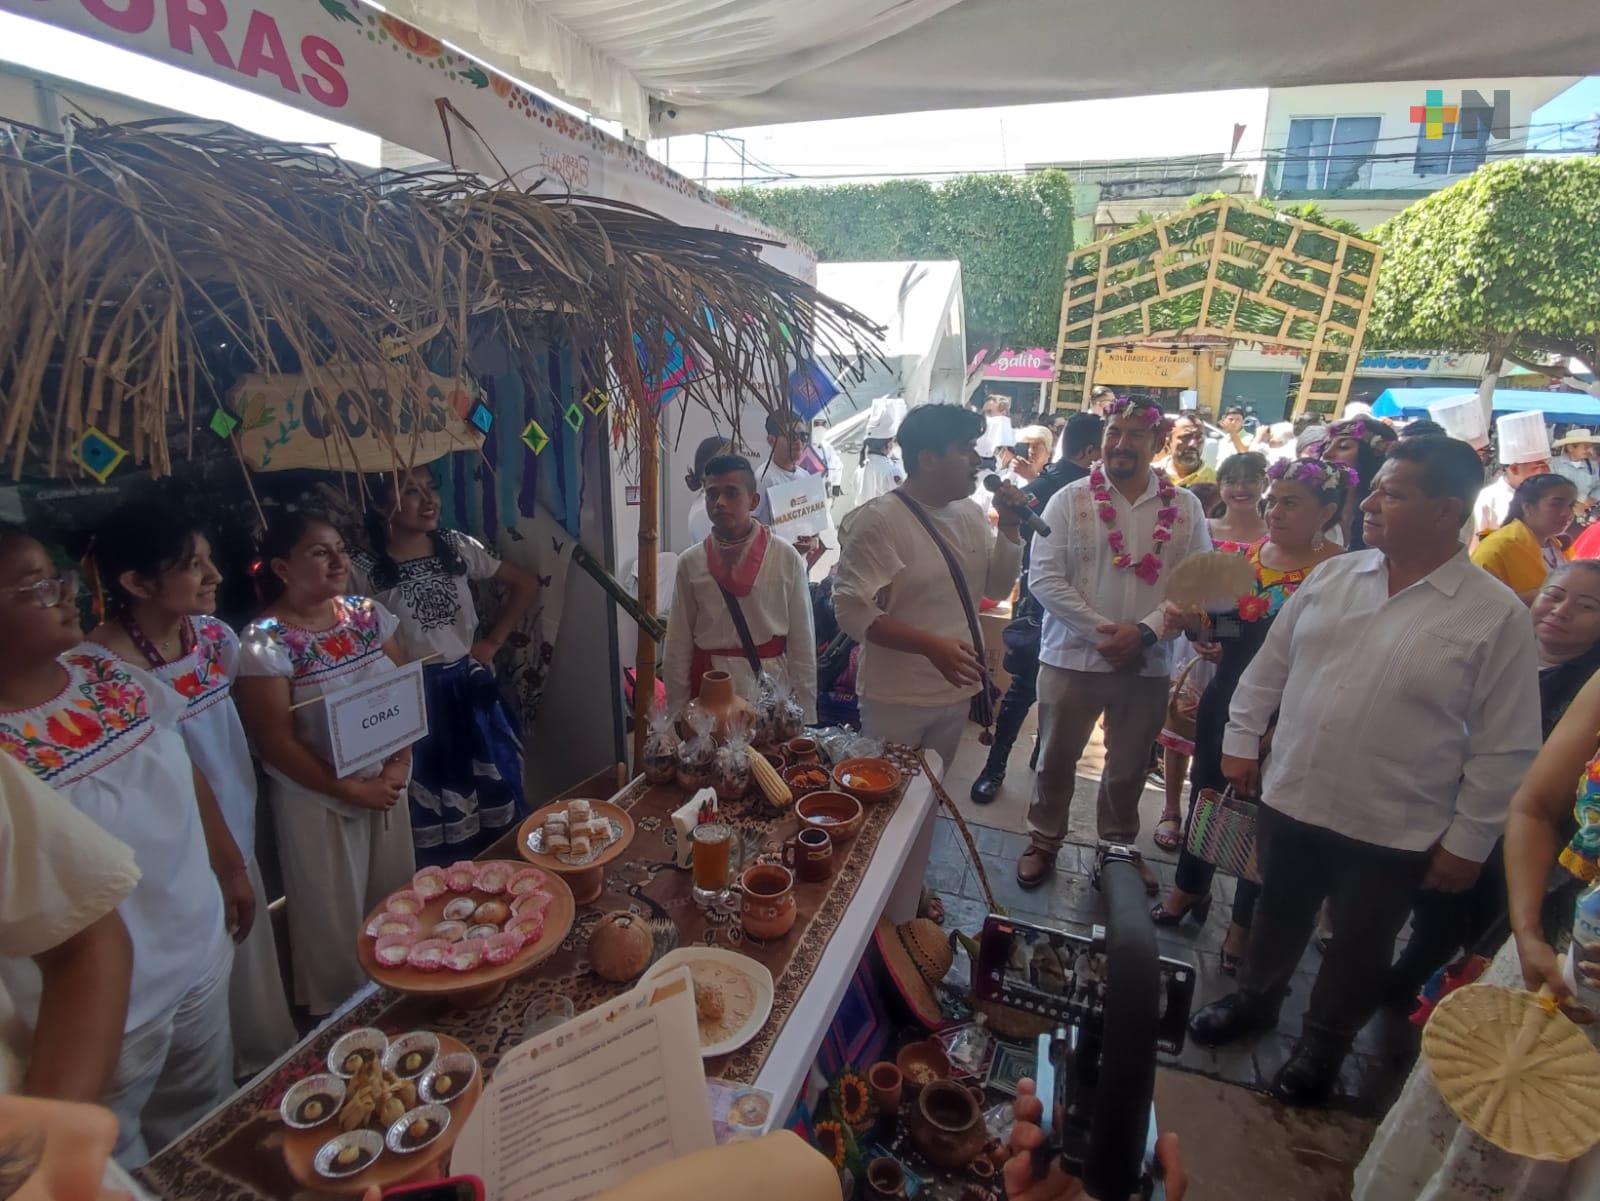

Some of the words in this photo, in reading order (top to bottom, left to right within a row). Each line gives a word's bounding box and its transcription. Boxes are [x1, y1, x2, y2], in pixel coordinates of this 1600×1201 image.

[36, 0, 348, 108] ORAS
[973, 353, 1041, 371] galito
[362, 704, 400, 729] CORAS
